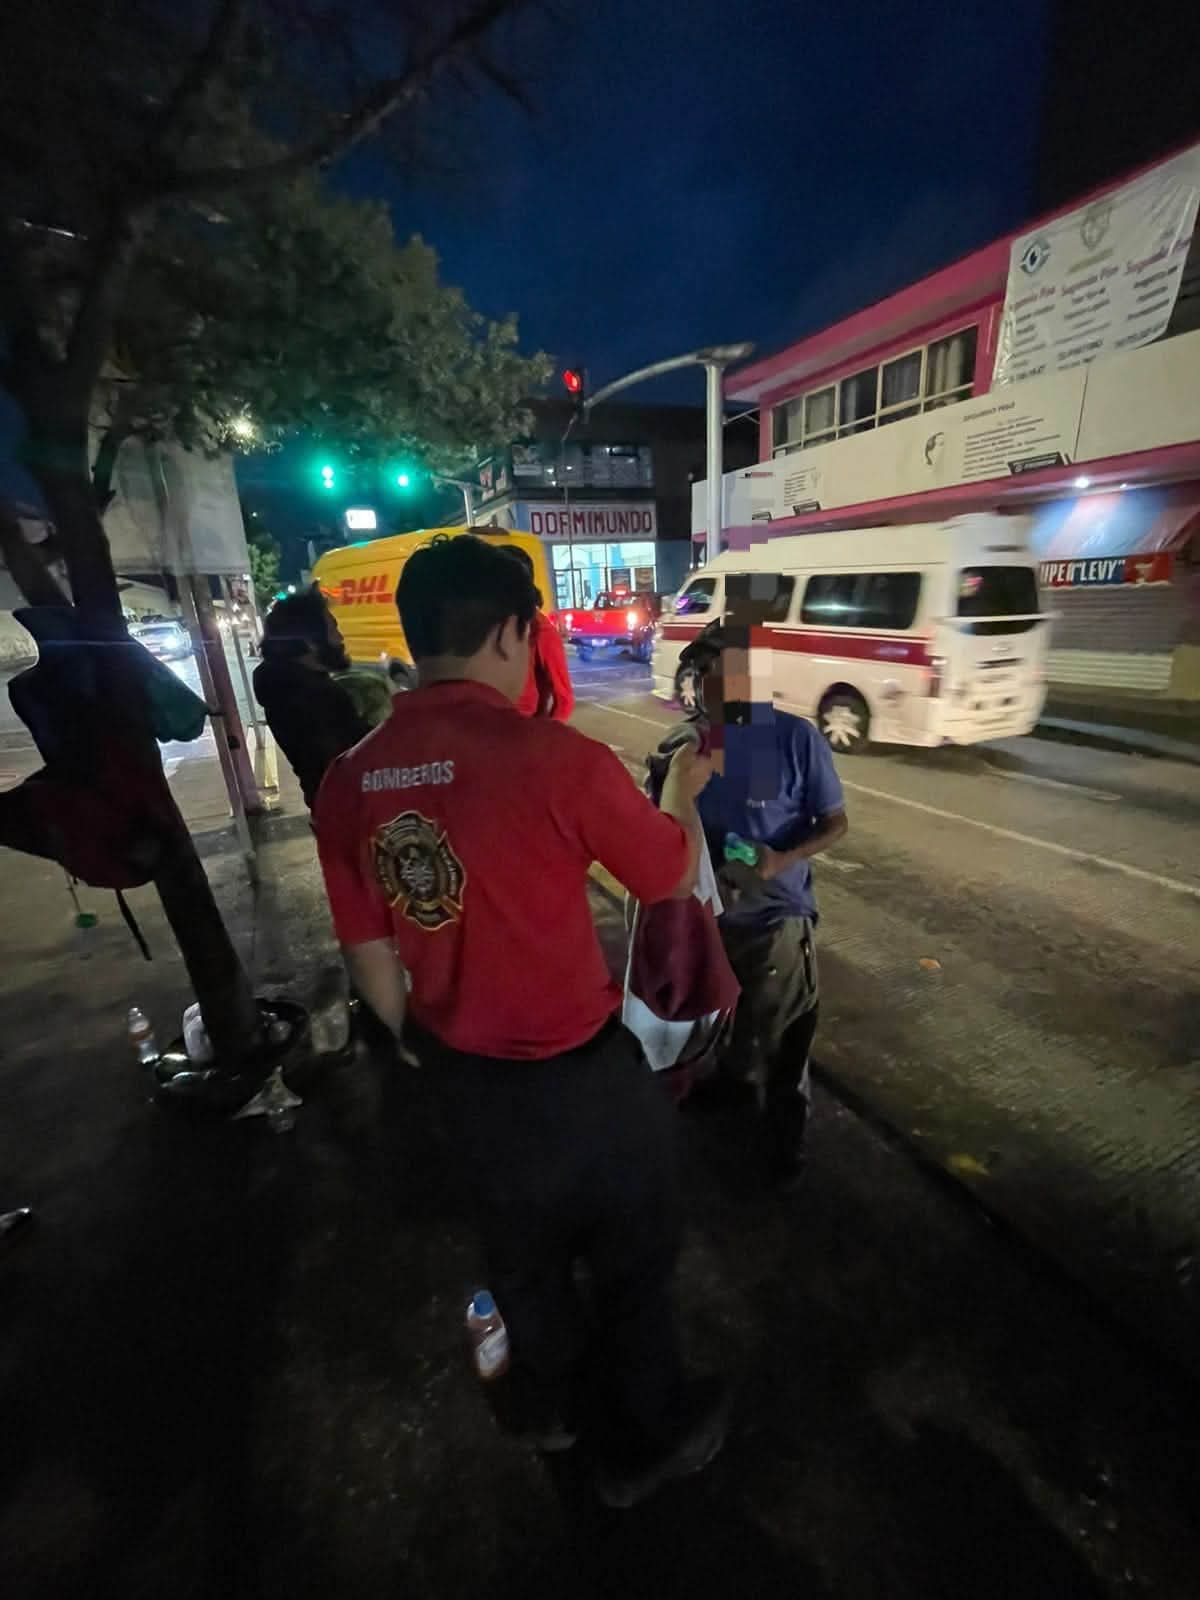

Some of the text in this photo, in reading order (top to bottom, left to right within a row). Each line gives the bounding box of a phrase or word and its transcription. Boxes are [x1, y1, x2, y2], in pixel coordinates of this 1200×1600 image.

[530, 510, 653, 536] DORMIMUNDO
[340, 574, 393, 605] DHL
[361, 760, 455, 793] BOMBEROS
